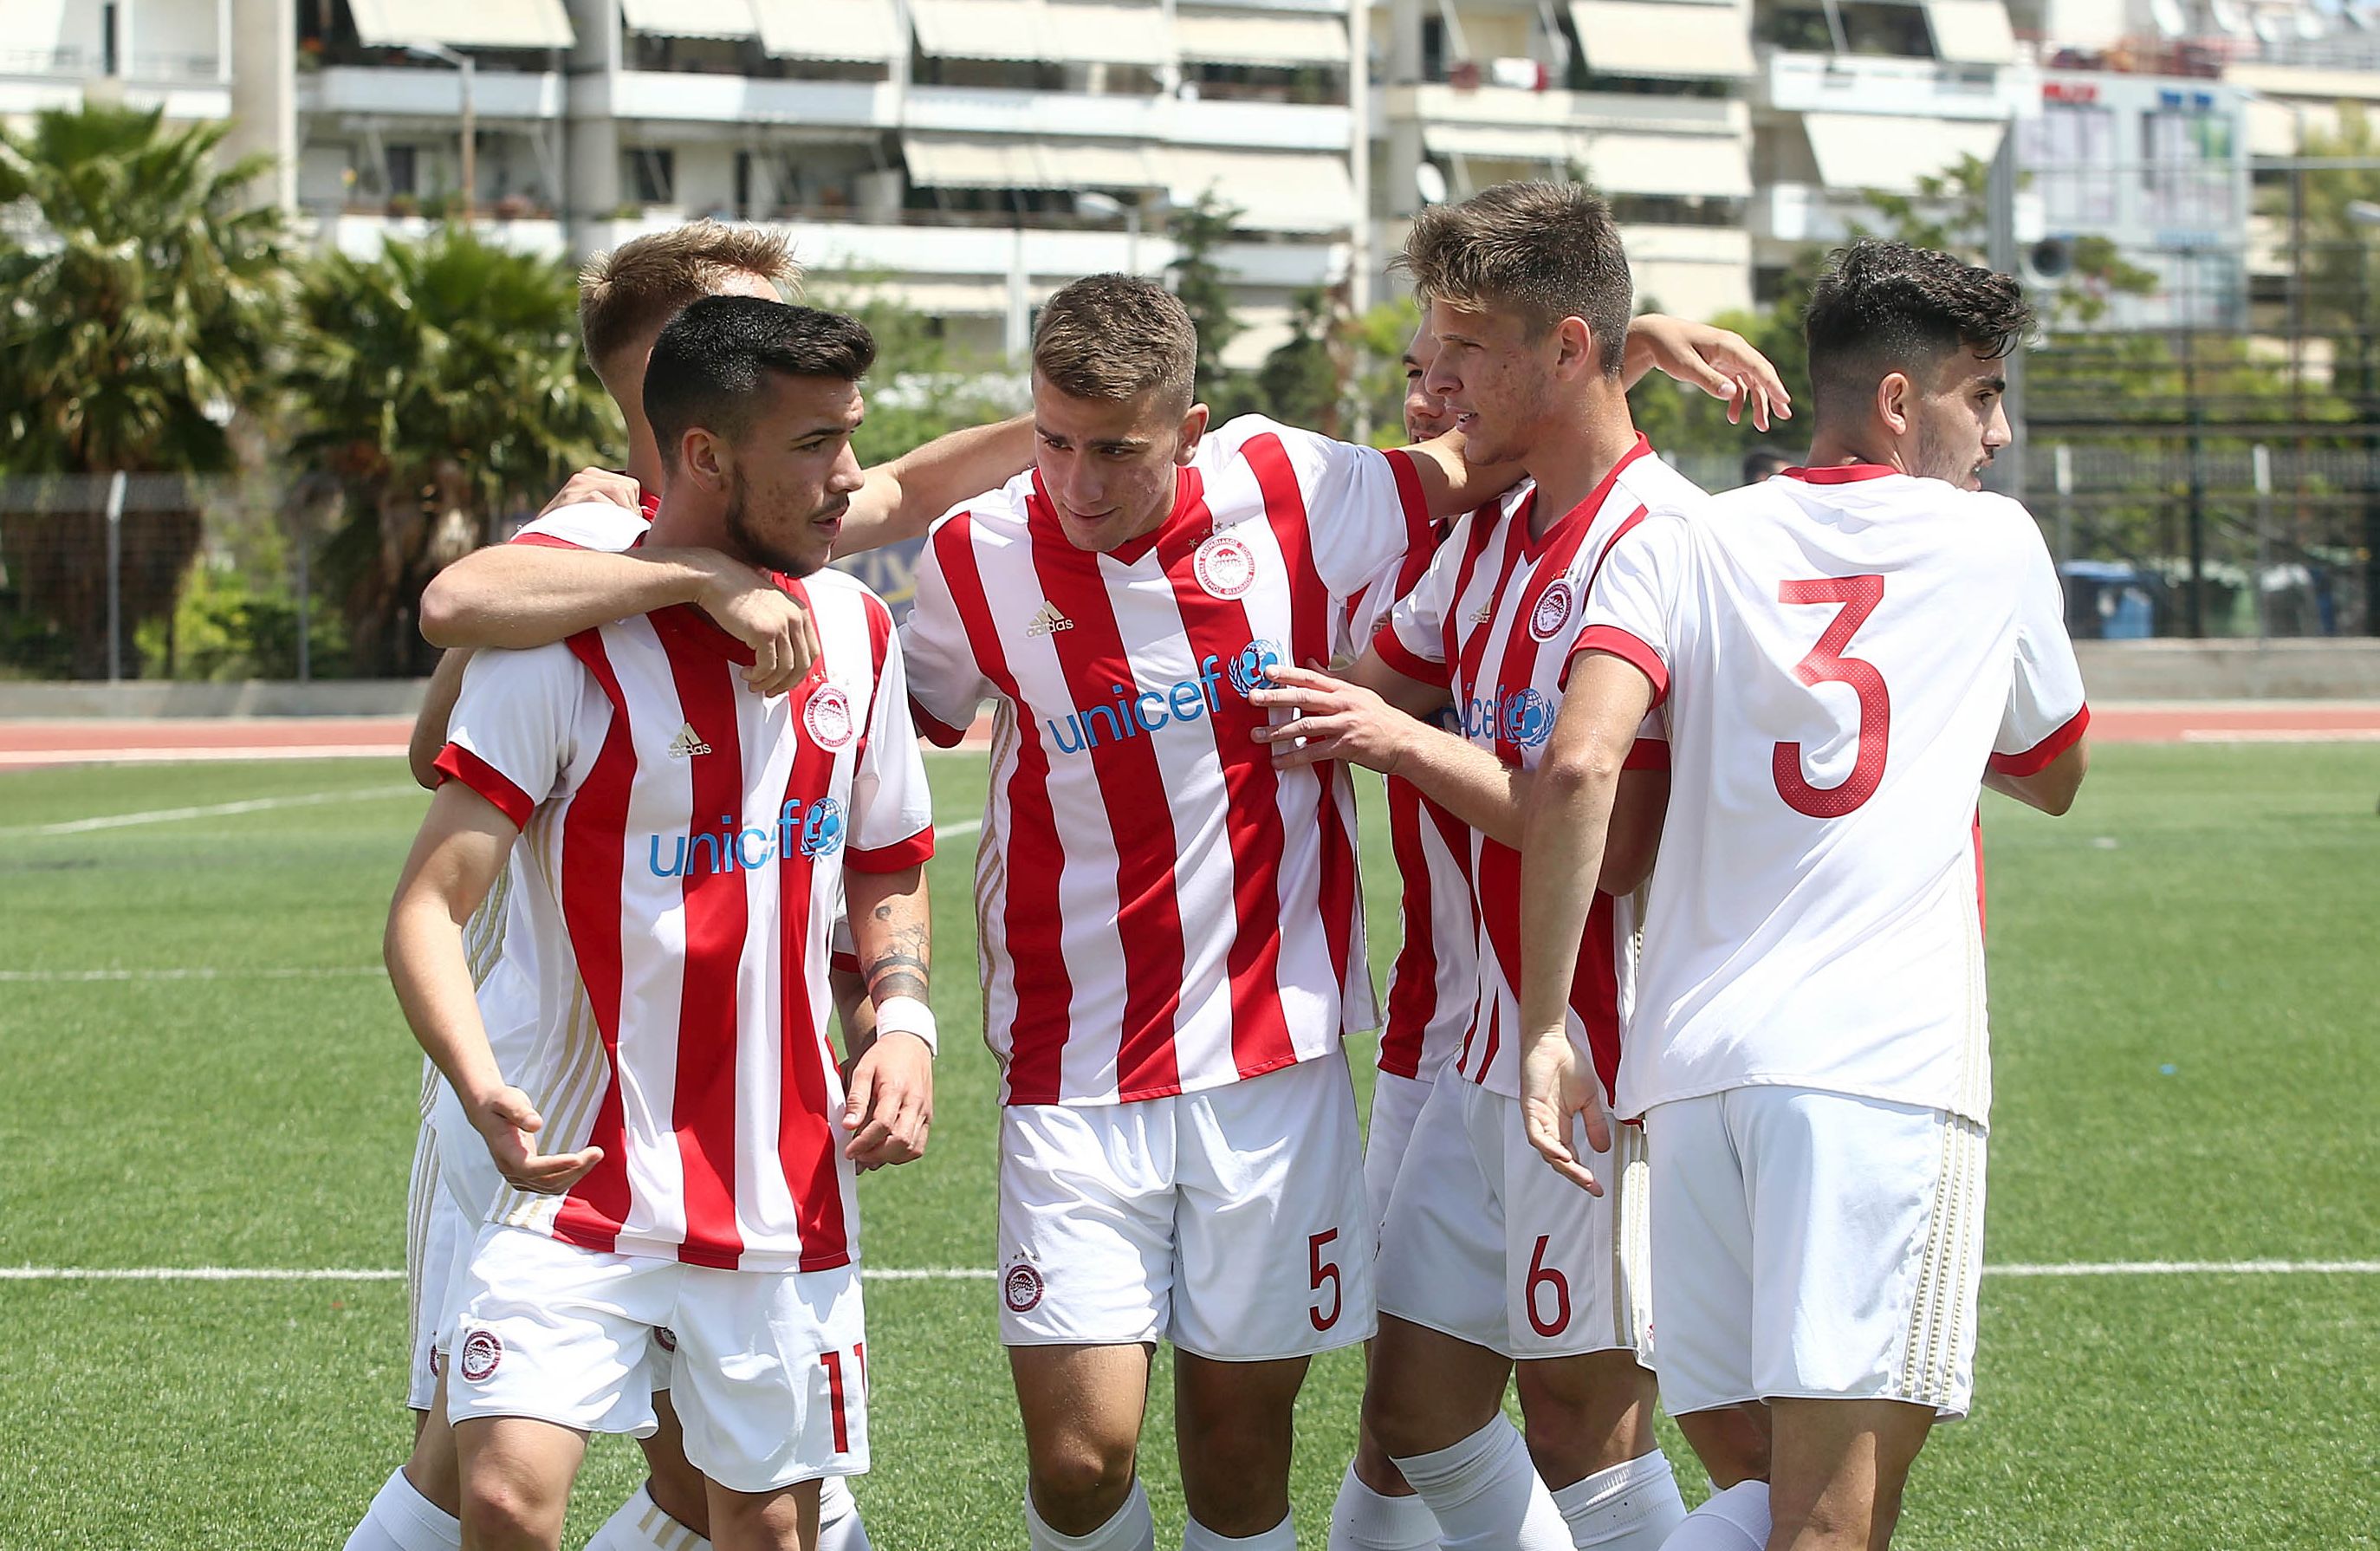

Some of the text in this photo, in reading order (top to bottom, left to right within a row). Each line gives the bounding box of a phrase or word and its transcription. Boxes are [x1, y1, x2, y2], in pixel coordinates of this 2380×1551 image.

[1047, 654, 1222, 754] unicef
[1773, 574, 1890, 818] 3
[1308, 1227, 1341, 1332] 5
[1525, 1234, 1571, 1337] 6
